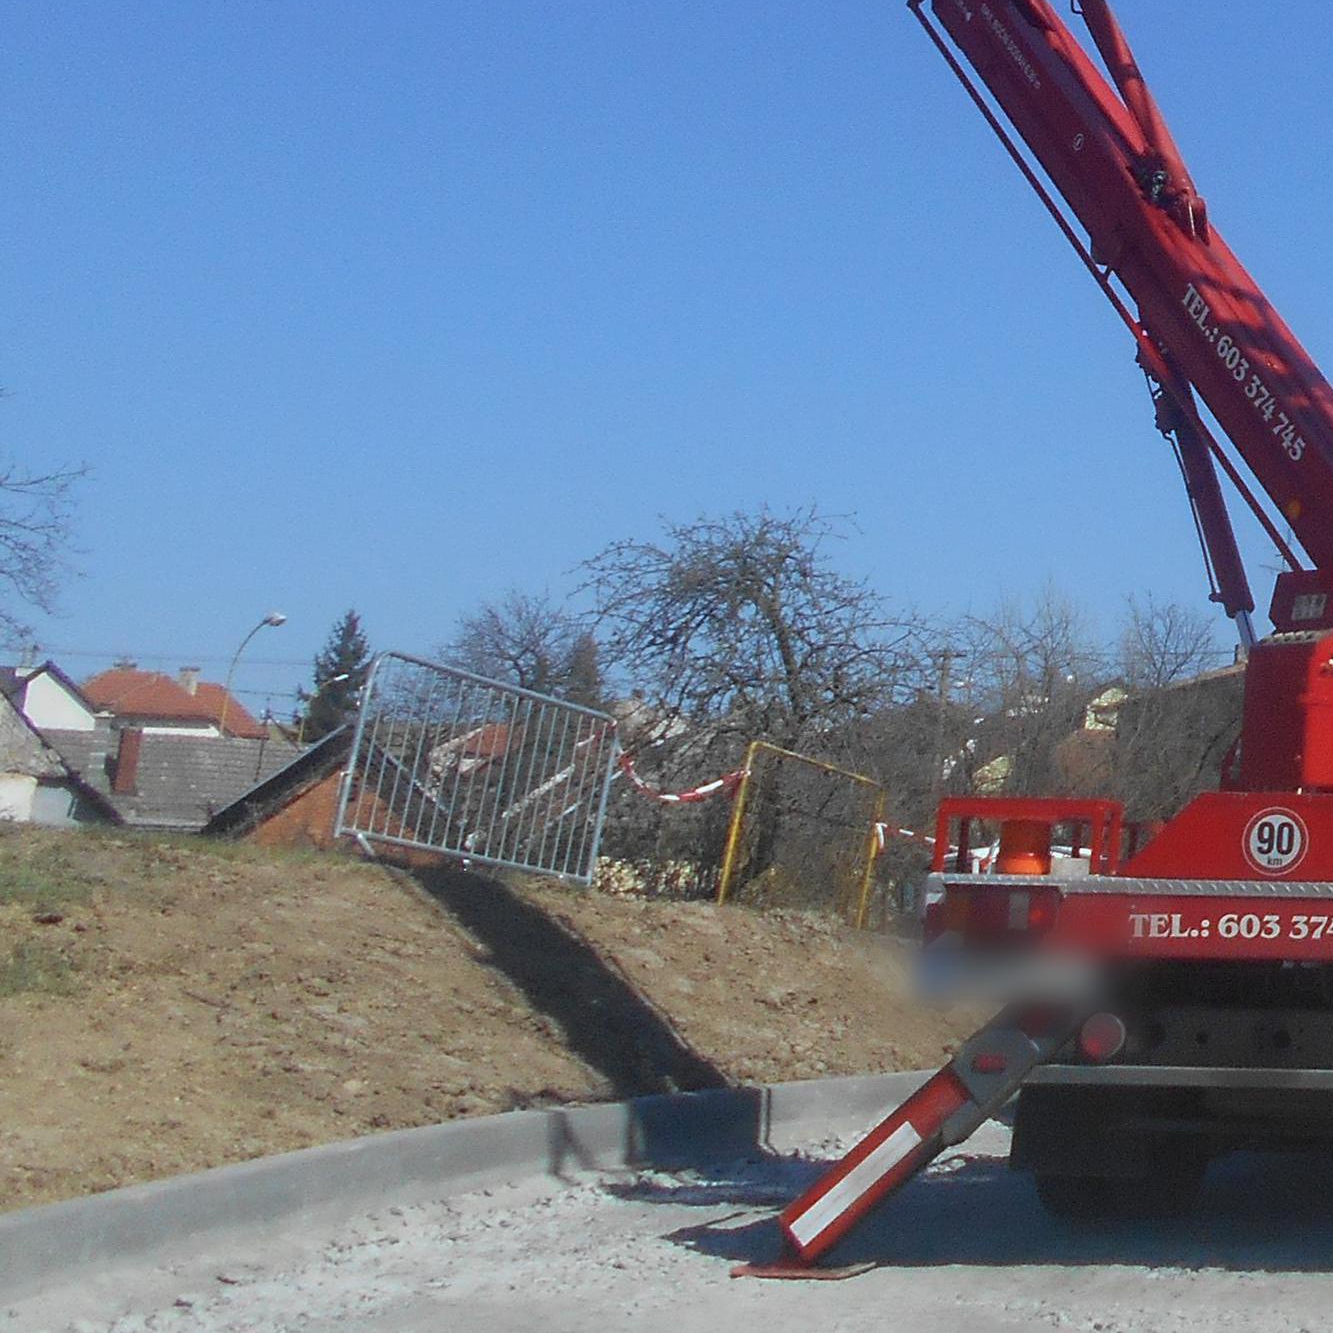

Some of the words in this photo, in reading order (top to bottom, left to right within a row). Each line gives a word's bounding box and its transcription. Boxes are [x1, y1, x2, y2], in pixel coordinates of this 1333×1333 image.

[1182, 282, 1219, 343] TEL.:
[1216, 335, 1250, 382] 603
[1244, 374, 1276, 422] 374
[1272, 412, 1306, 461] 745
[1256, 821, 1295, 856] 90
[1266, 855, 1283, 866] km
[1129, 913, 1211, 939] TEL.:
[1217, 914, 1281, 939] 603
